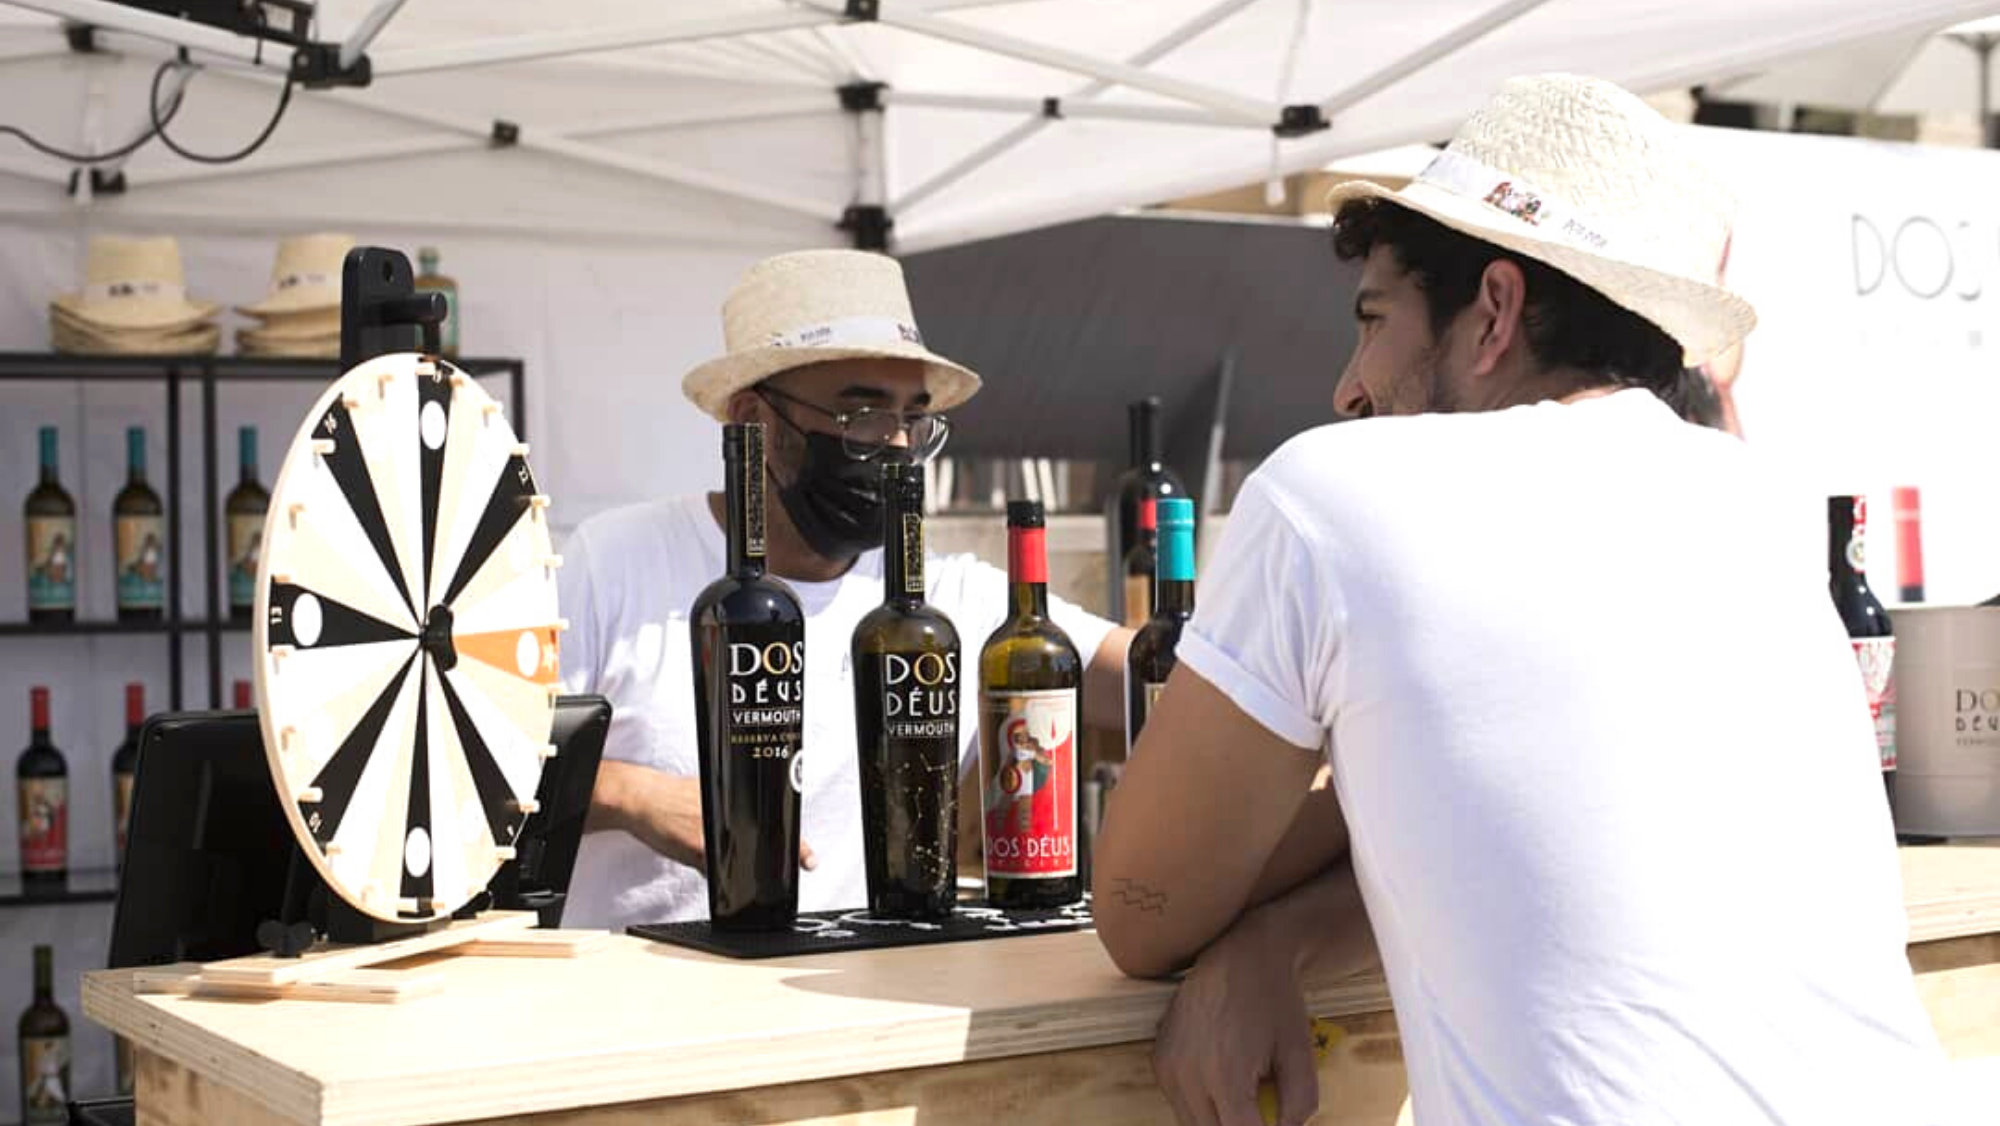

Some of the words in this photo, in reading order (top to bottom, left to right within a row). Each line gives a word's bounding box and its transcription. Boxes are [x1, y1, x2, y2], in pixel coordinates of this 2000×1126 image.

[729, 641, 803, 676] DOS
[885, 651, 957, 685] DOS
[731, 678, 803, 703] DÉUS
[886, 686, 956, 716] DÉUS
[752, 745, 789, 759] 2016
[1026, 833, 1071, 858] DÉUS
